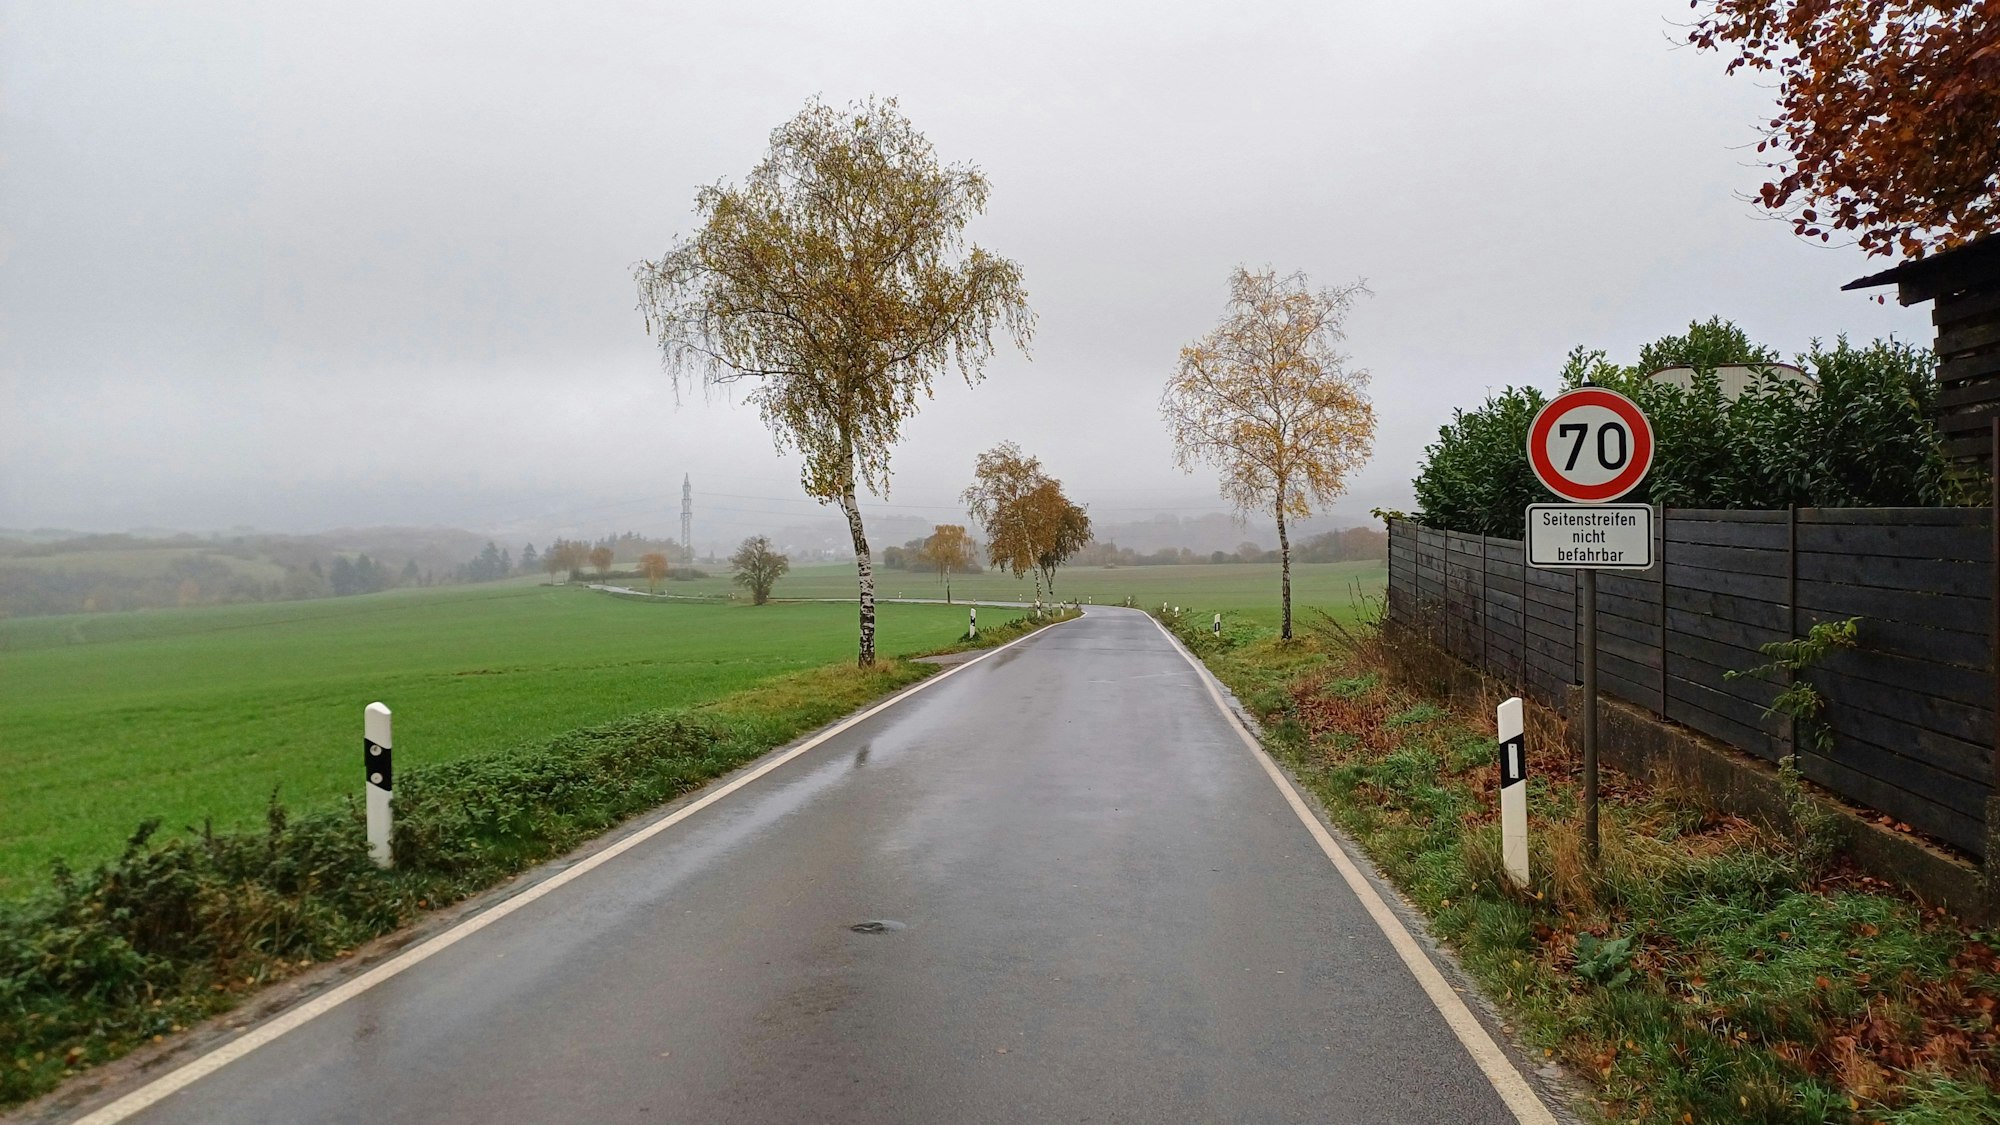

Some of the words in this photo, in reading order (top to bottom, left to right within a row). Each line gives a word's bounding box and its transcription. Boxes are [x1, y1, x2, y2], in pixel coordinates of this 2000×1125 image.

[1559, 421, 1627, 471] 70
[1543, 512, 1636, 526] Seitenstreifen
[1572, 529, 1606, 544] nicht
[1558, 547, 1624, 562] befahrbar
